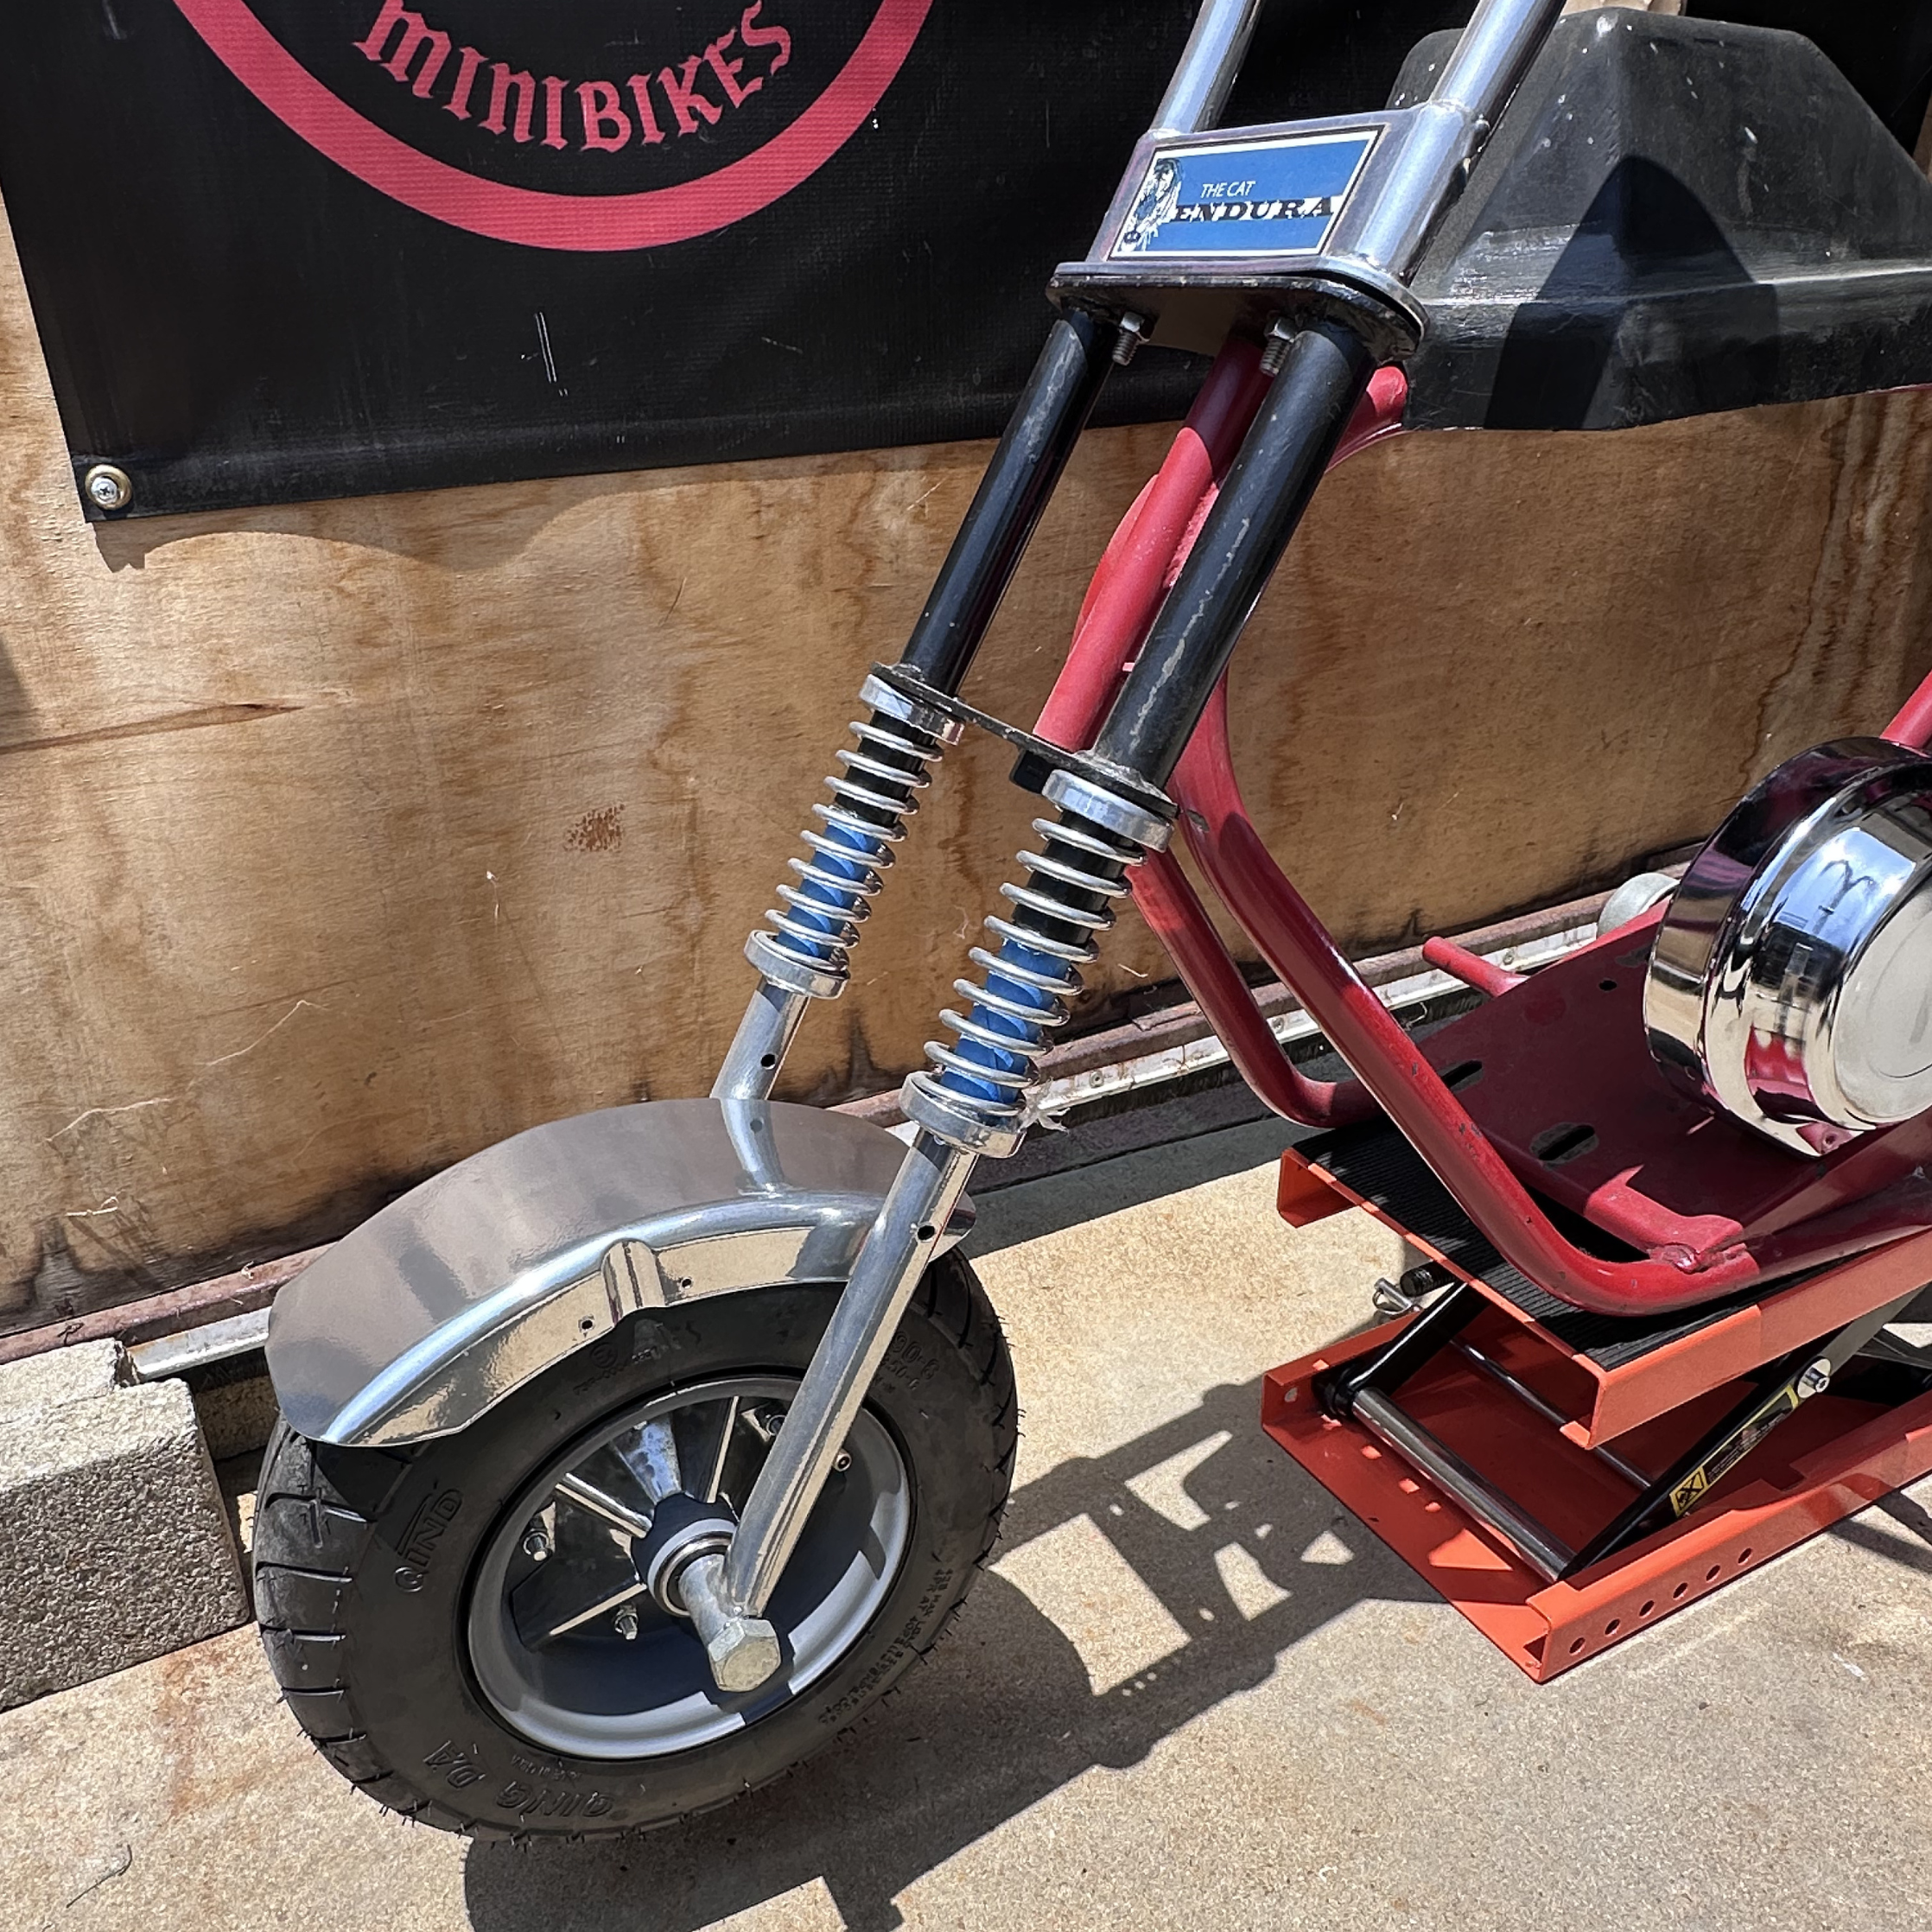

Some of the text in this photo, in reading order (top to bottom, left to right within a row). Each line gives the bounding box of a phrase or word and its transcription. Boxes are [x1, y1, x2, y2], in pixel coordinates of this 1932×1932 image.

[1200, 180, 1256, 199] THE CAT
[1171, 197, 1334, 222] ENDURA
